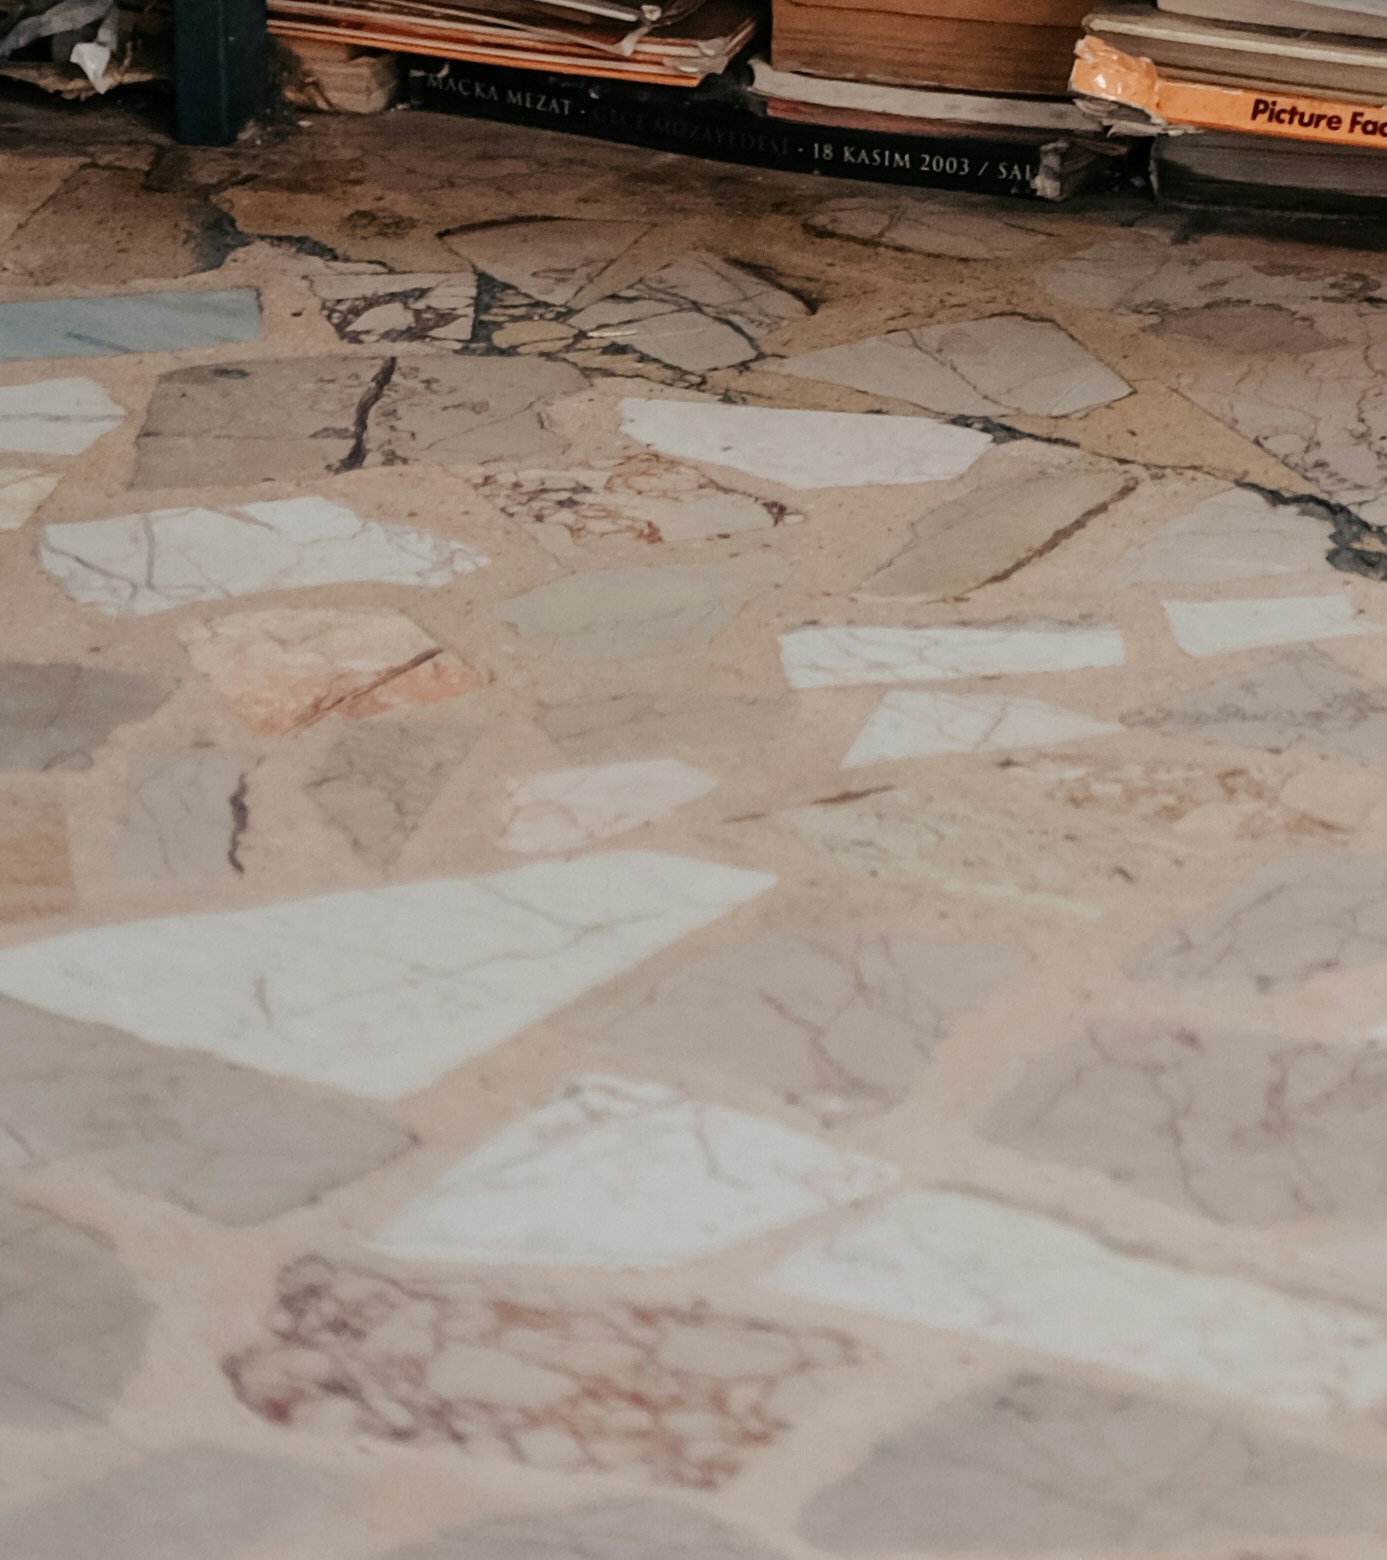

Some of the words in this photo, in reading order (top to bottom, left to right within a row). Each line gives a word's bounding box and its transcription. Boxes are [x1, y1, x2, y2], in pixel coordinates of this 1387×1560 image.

[1250, 97, 1345, 134] Picture
[811, 141, 835, 161] 18
[842, 143, 912, 169] KASIM
[920, 151, 971, 176] 2003
